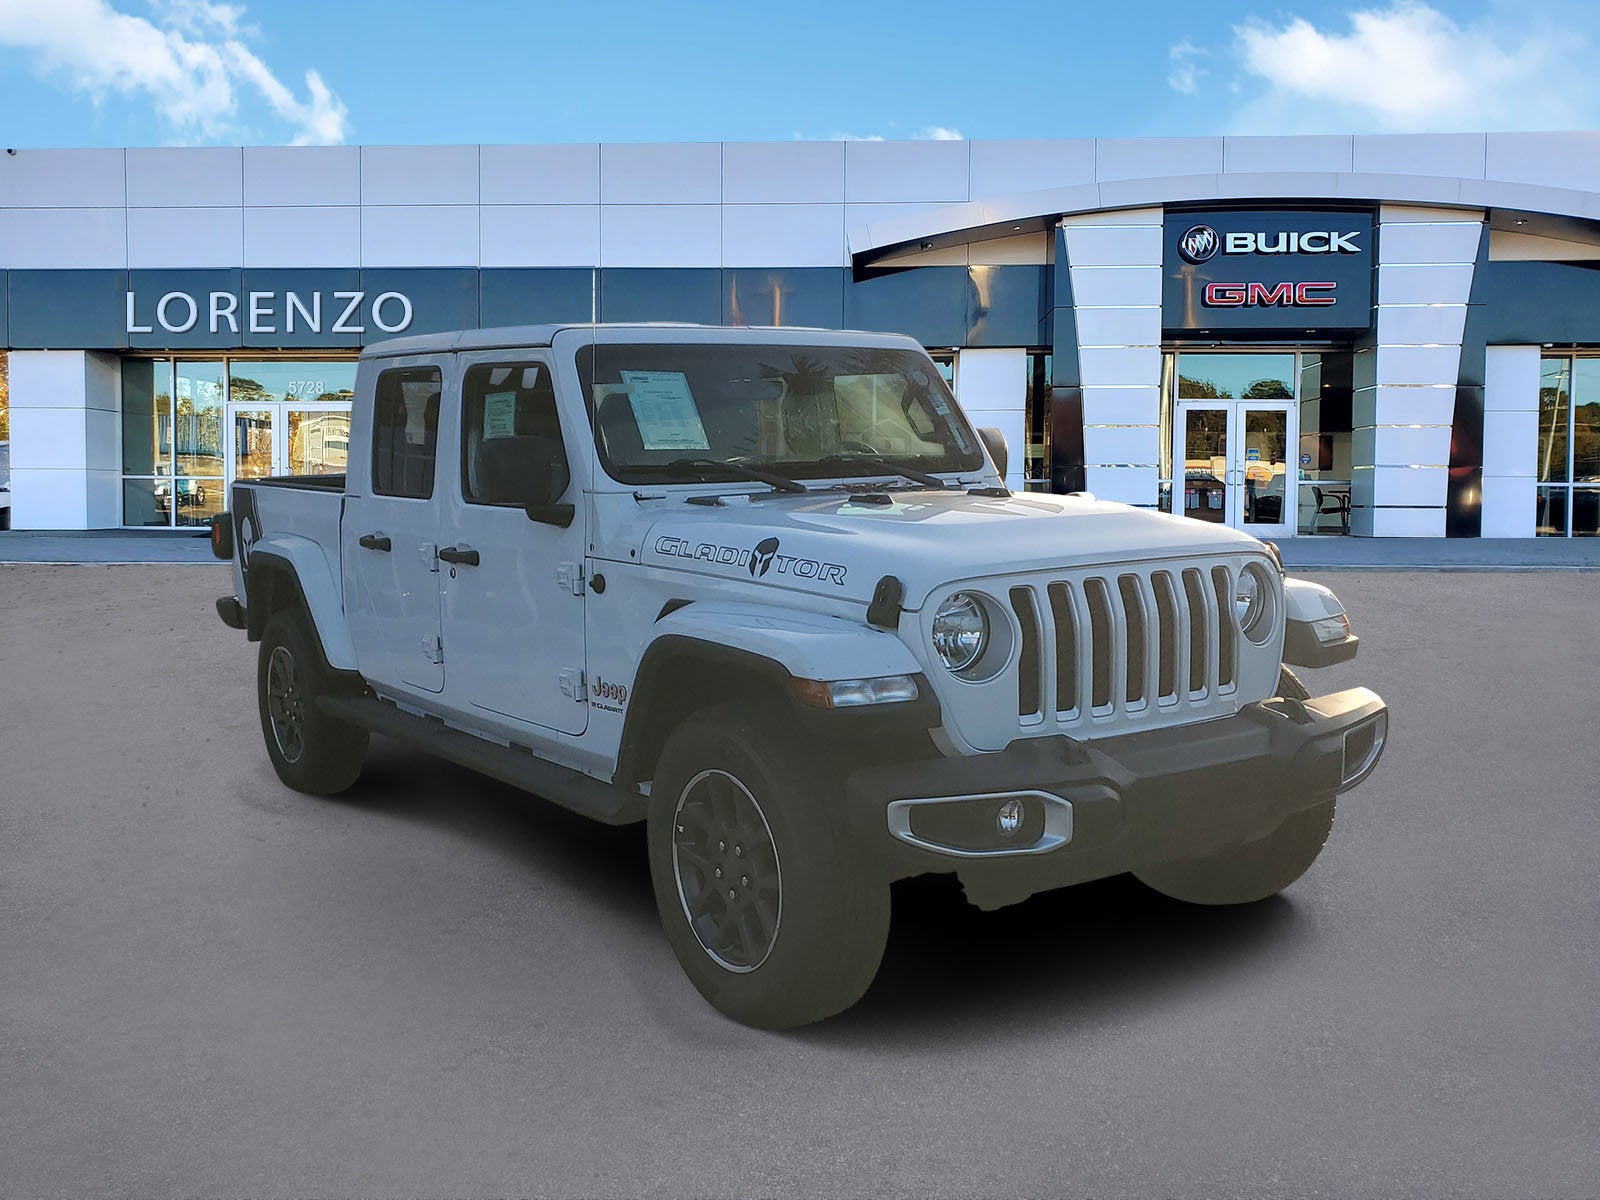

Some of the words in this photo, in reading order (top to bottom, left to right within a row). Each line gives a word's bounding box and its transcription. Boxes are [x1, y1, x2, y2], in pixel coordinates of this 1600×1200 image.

[1225, 231, 1362, 253] BUICK
[1205, 281, 1337, 305] GMC
[126, 290, 413, 334] LORENZO
[288, 380, 325, 394] 5728
[654, 535, 848, 586] GLADITOR
[592, 676, 627, 705] Jeep
